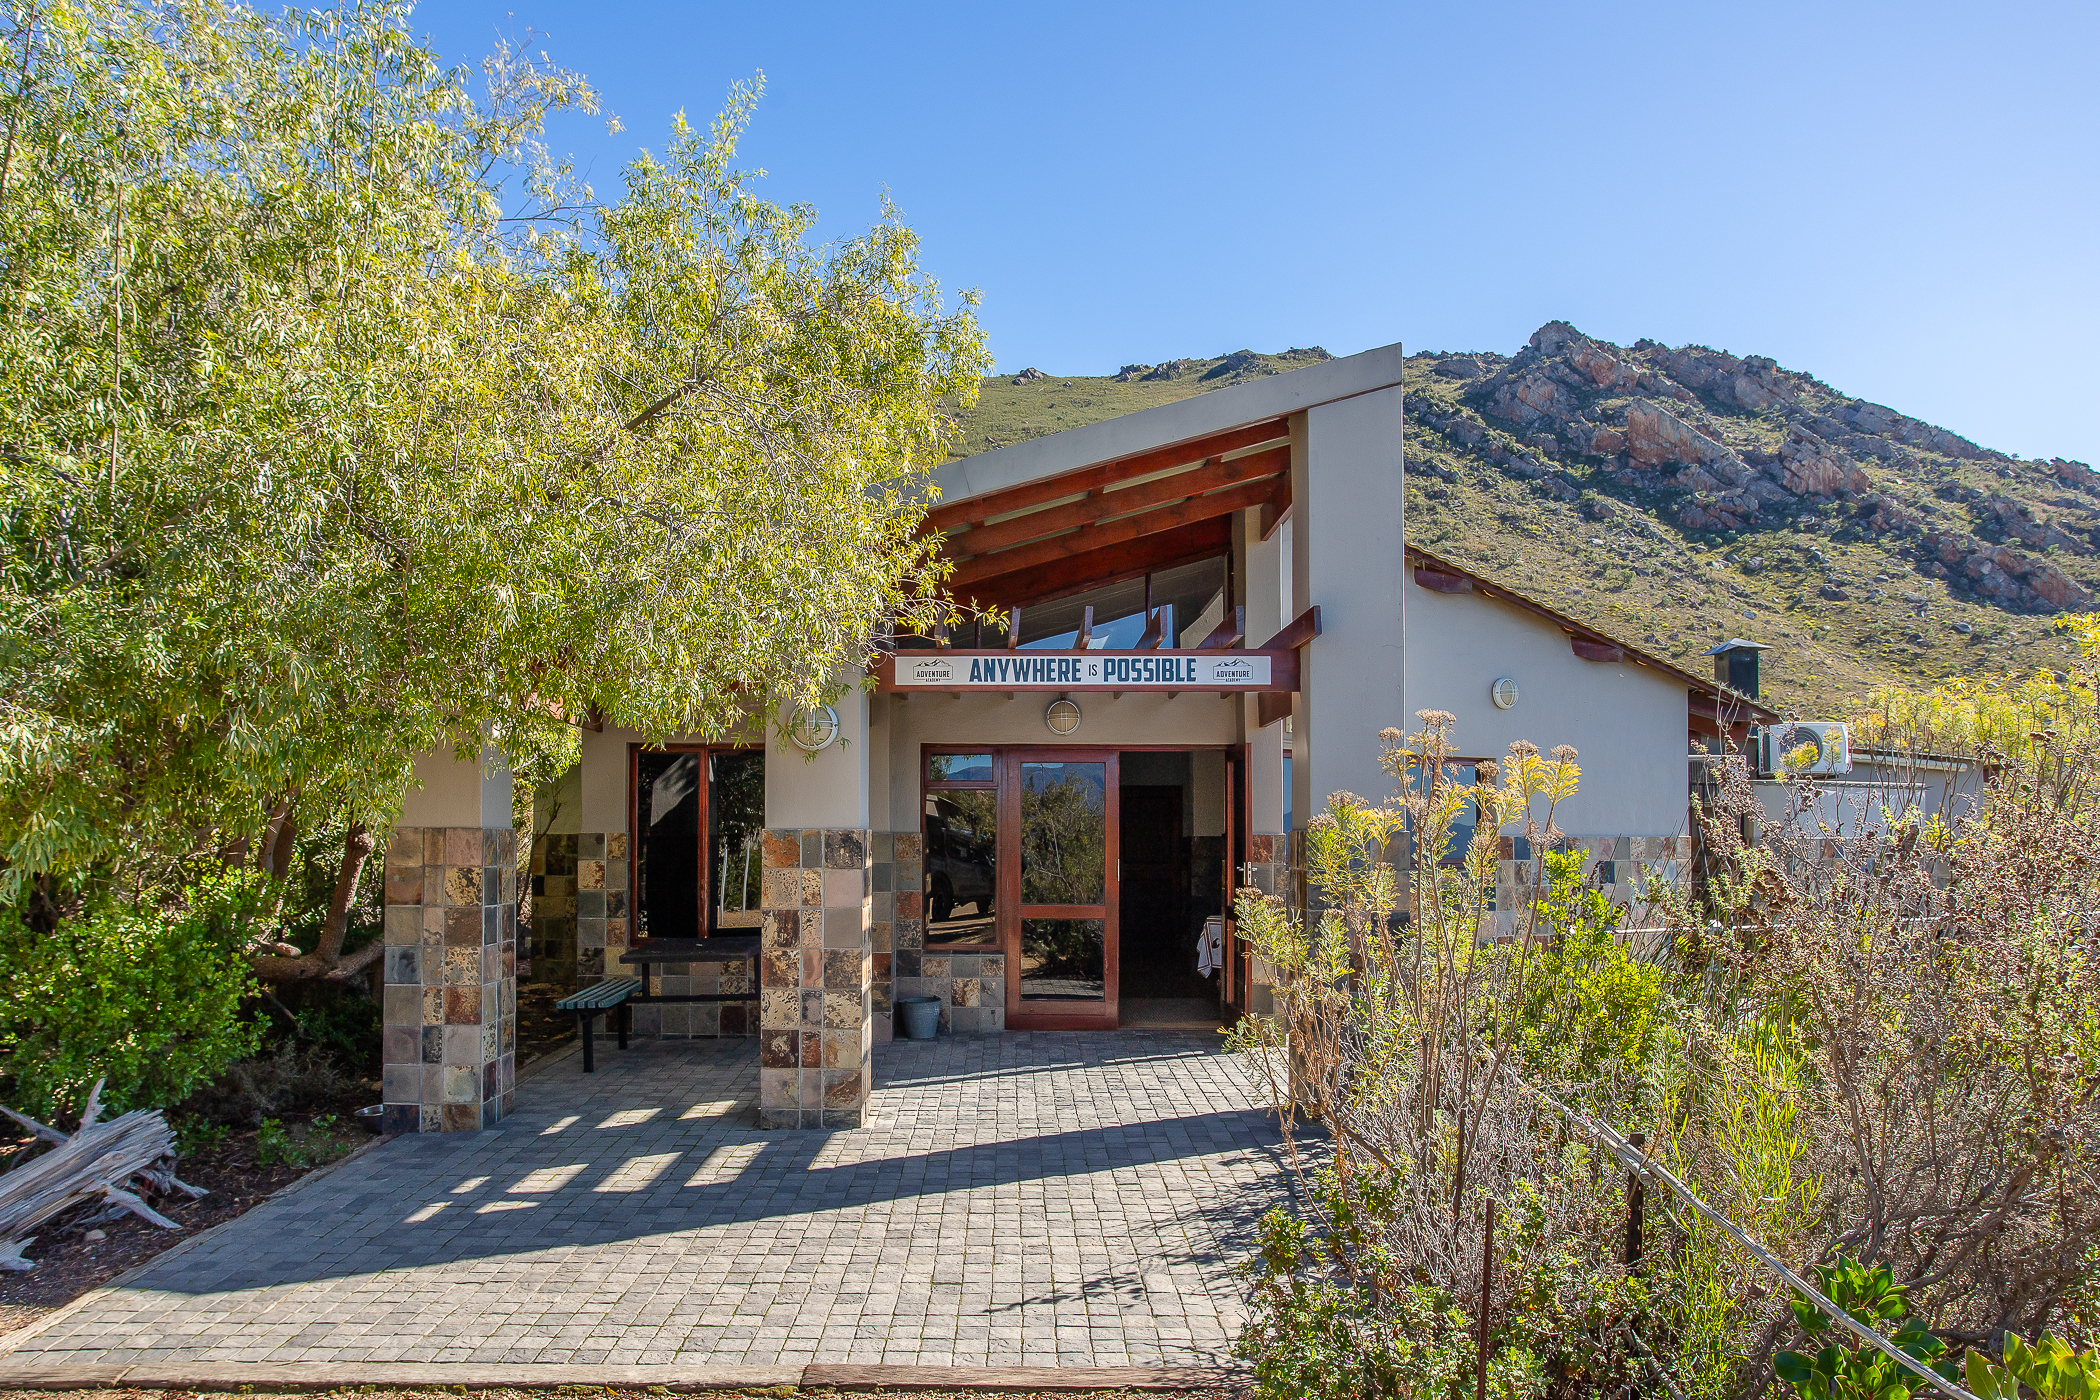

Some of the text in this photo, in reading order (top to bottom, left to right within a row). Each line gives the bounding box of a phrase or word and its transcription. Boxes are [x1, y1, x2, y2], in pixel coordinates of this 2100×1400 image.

[916, 670, 950, 678] ADVENTURE
[969, 658, 1197, 682] ANYWHERE IS POSSIBLE
[1216, 670, 1250, 678] ADVENTURE
